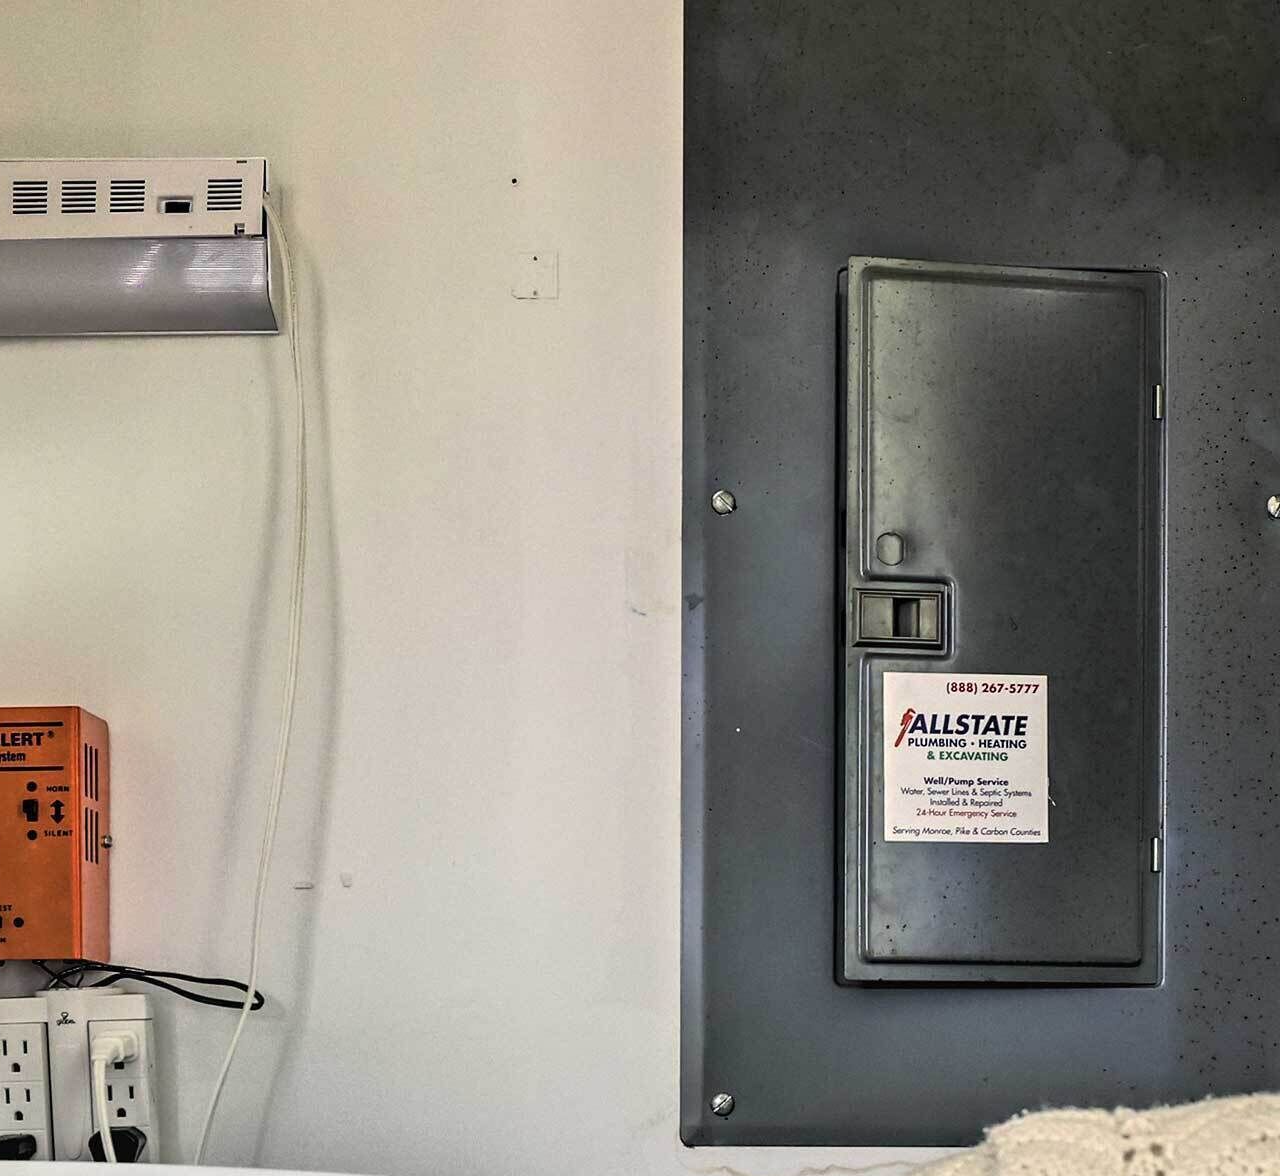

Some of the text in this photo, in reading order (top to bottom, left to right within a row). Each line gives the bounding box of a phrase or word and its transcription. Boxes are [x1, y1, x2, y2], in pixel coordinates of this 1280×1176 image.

[946, 682, 1039, 695] (888) 267-5777
[908, 713, 1028, 736] ALLSTATE
[908, 737, 1027, 749] PLUMBING HEATING
[927, 751, 1008, 761] & EXCAVATING
[923, 776, 1009, 787] Well/Pump Service
[901, 788, 1032, 798] Water, Sewer Lines & Septic Systems
[929, 798, 960, 806] Installed
[970, 799, 1003, 808] Repaired
[916, 808, 1017, 818] 24-Hour Emergency Service
[44, 829, 73, 837] SILENT
[892, 826, 920, 836] Serving
[922, 827, 953, 836] Monroe,
[955, 827, 970, 835] Pike
[981, 828, 1008, 836] Carbon
[1010, 828, 1041, 836] Counties
